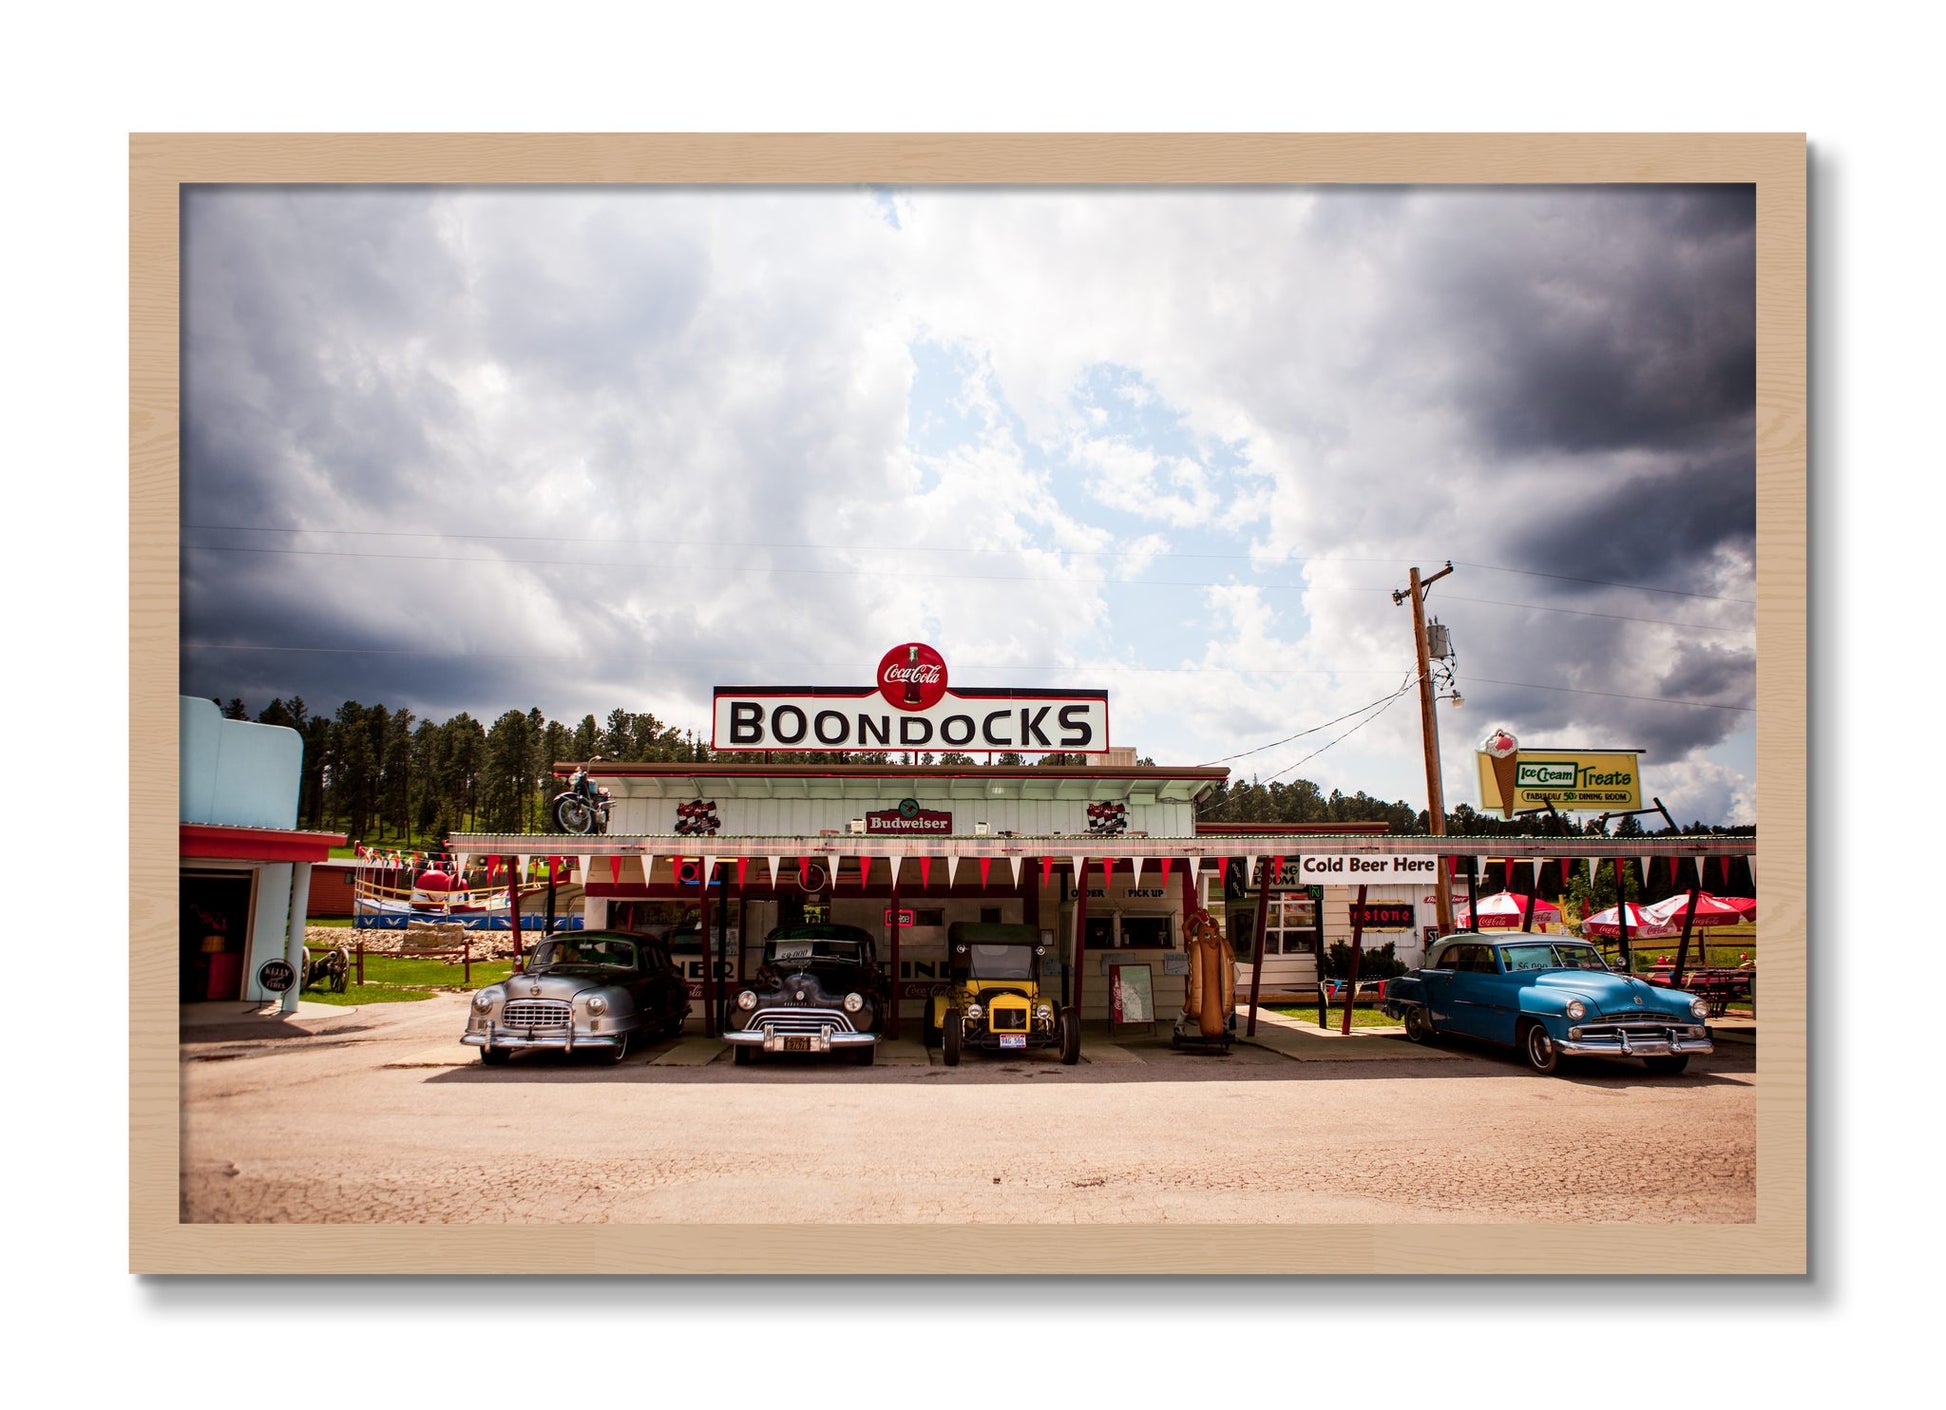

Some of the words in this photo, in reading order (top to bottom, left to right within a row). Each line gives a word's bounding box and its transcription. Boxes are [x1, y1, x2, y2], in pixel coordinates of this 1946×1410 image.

[883, 663, 942, 684] Coca-Cola
[729, 701, 1093, 747] BOONDOCKS
[1520, 767, 1536, 780] Ice
[1537, 767, 1573, 782] Cream
[1578, 766, 1632, 788] Treats
[870, 817, 948, 829] Budweiser
[1303, 857, 1343, 872] Cold
[1349, 857, 1388, 872] Beer
[1393, 857, 1435, 872] Here
[1071, 889, 1105, 897] ODER
[1128, 889, 1150, 898] PICK
[1151, 889, 1164, 897] UP
